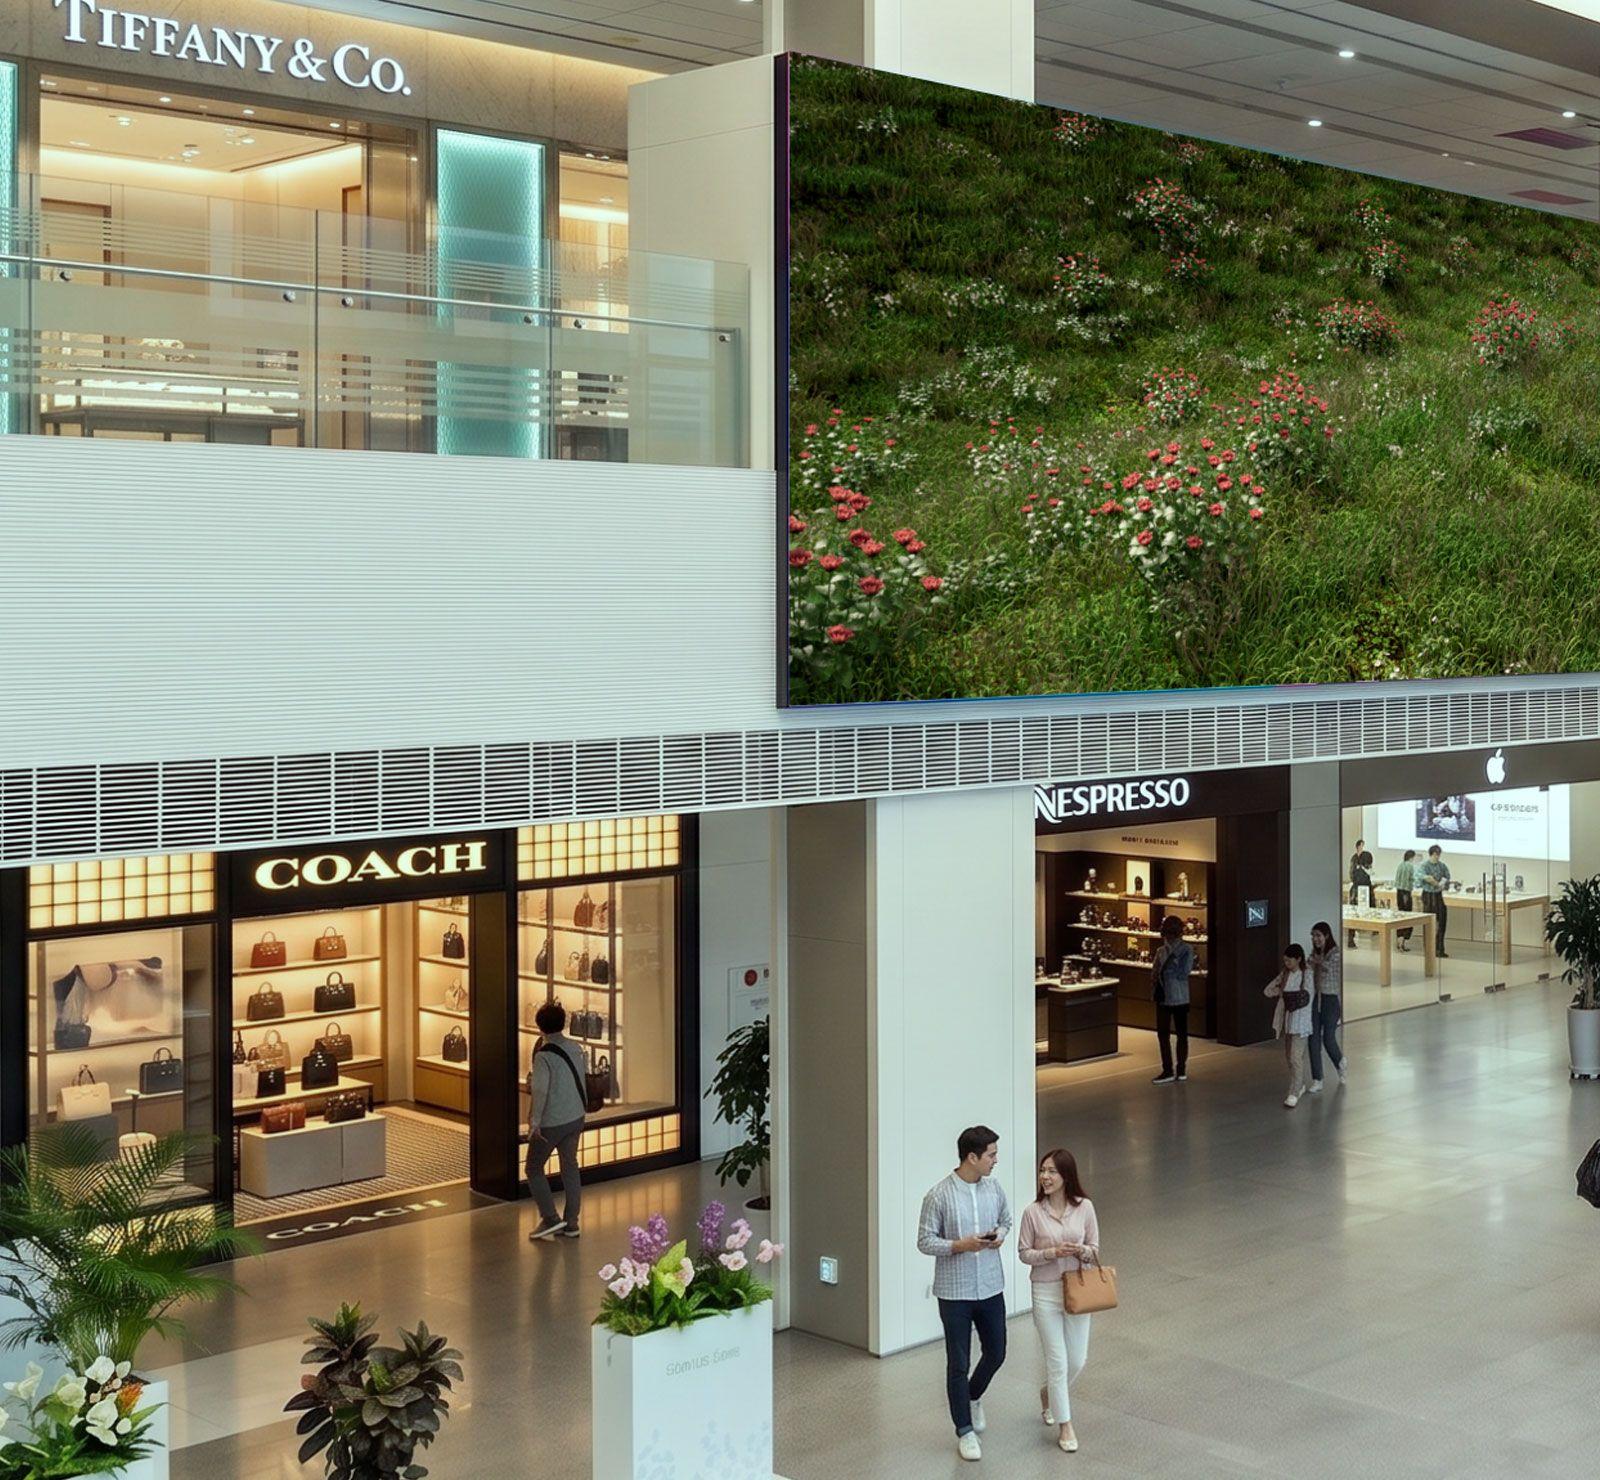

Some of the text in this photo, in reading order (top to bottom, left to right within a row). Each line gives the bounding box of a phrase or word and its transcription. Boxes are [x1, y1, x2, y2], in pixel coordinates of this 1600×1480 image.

[54, 0, 283, 74] TIFFANY
[287, 38, 327, 82] &
[1034, 777, 1191, 824] NESPRESSO
[255, 842, 487, 890] COACH
